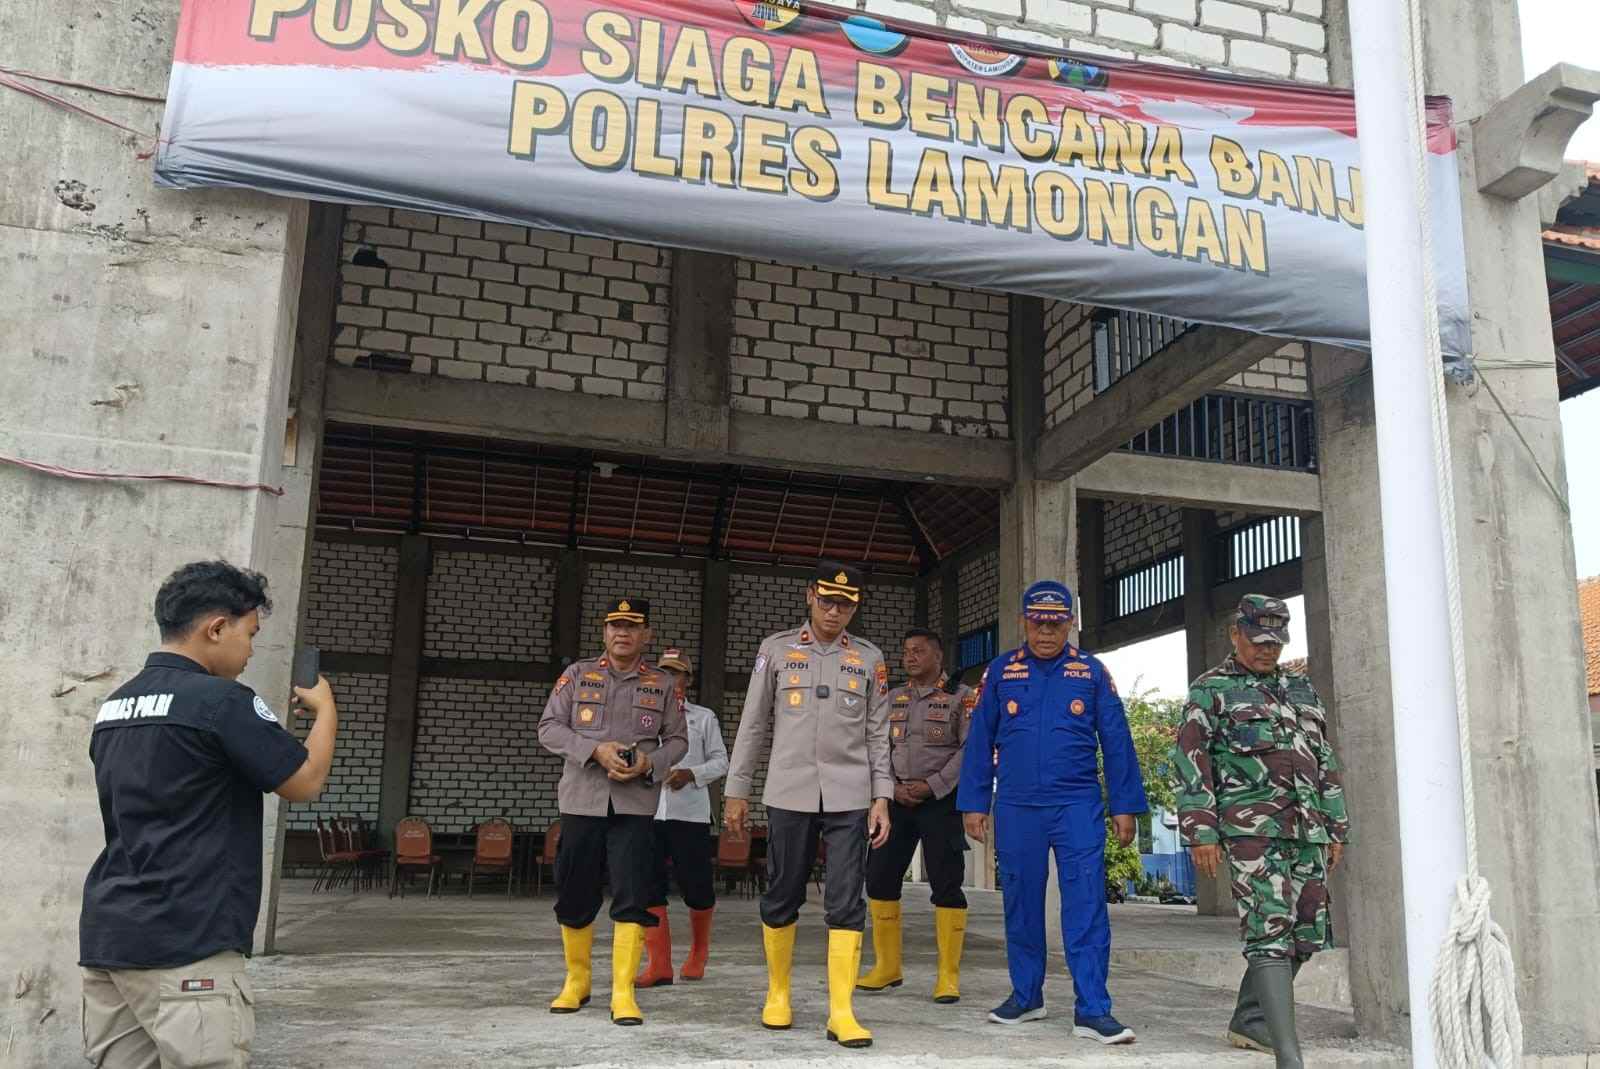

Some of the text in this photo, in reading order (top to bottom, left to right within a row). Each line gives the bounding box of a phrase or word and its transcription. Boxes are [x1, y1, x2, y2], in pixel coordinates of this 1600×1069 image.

[580, 12, 830, 116] SIAGA
[855, 58, 1195, 187] BENCANA
[507, 80, 1270, 277] POLRES LAMONGAN
[783, 661, 809, 670] JODI
[840, 665, 866, 677] POLRI
[1063, 670, 1092, 680] POLRI
[580, 680, 605, 689] BUDI
[636, 687, 664, 696] POLRI
